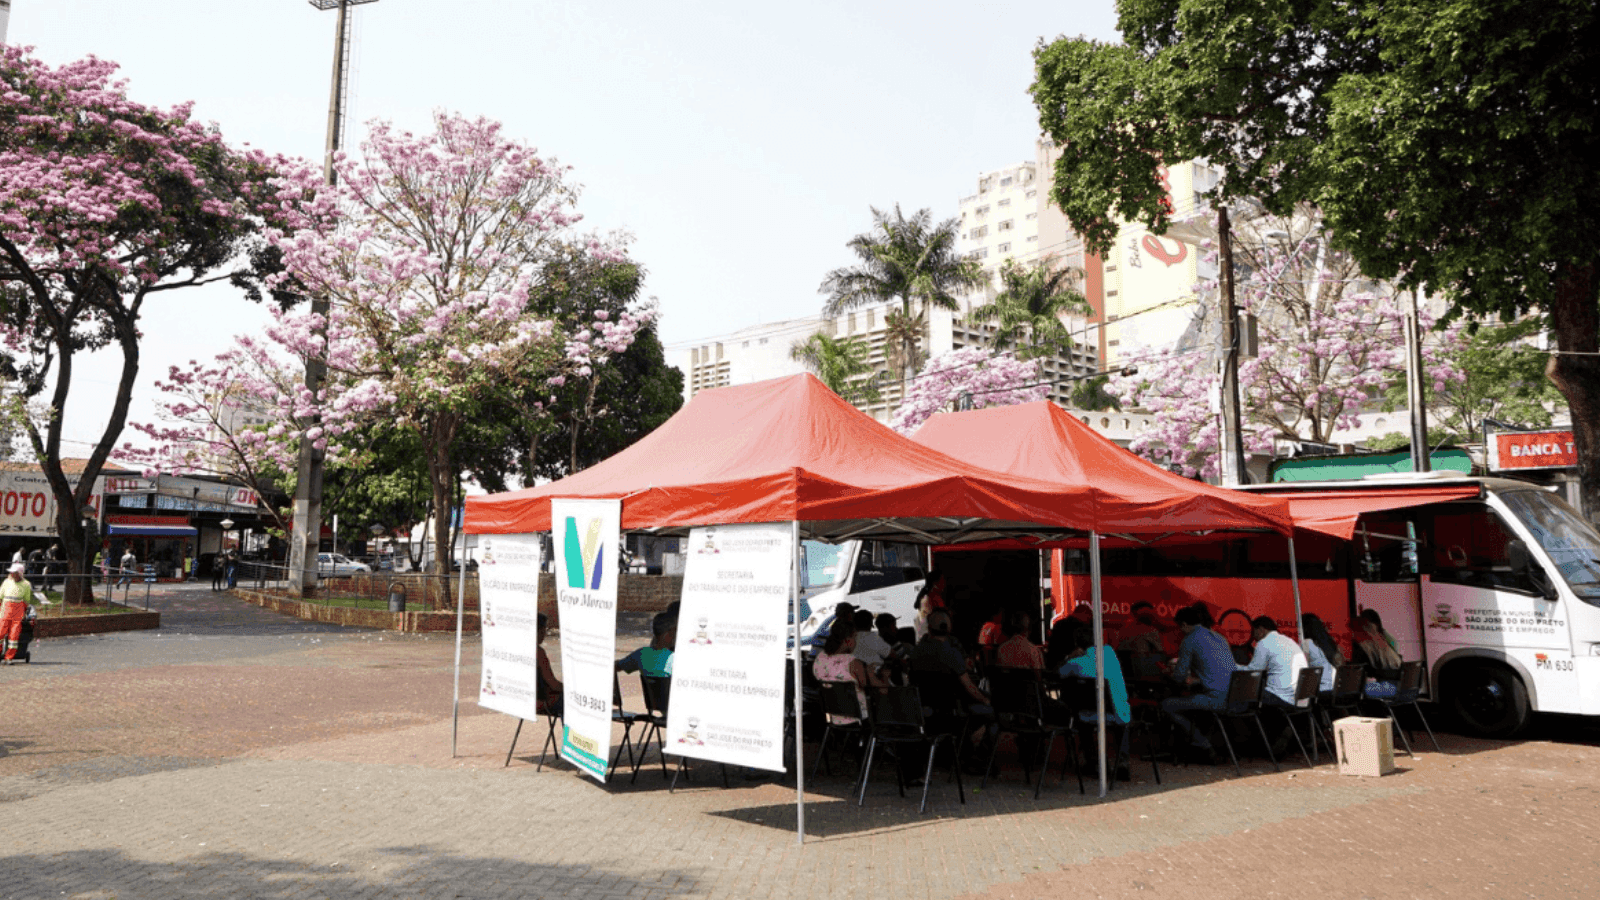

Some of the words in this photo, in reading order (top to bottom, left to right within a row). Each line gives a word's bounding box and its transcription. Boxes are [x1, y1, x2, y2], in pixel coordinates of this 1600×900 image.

[1510, 443, 1562, 457] BANCA
[14, 476, 48, 484] Centra
[1463, 608, 1507, 616] PREFEITURA
[1465, 624, 1507, 632] TRABALHO
[1536, 619, 1565, 627] PRETO
[1536, 659, 1553, 670] PM
[1555, 660, 1574, 671] 630
[710, 668, 747, 680] SECRETARIA
[676, 678, 689, 688] DO
[691, 680, 724, 692] TRABALHO
[725, 684, 729, 693] E
[730, 684, 741, 694] DO
[742, 686, 780, 699] EMPREGO
